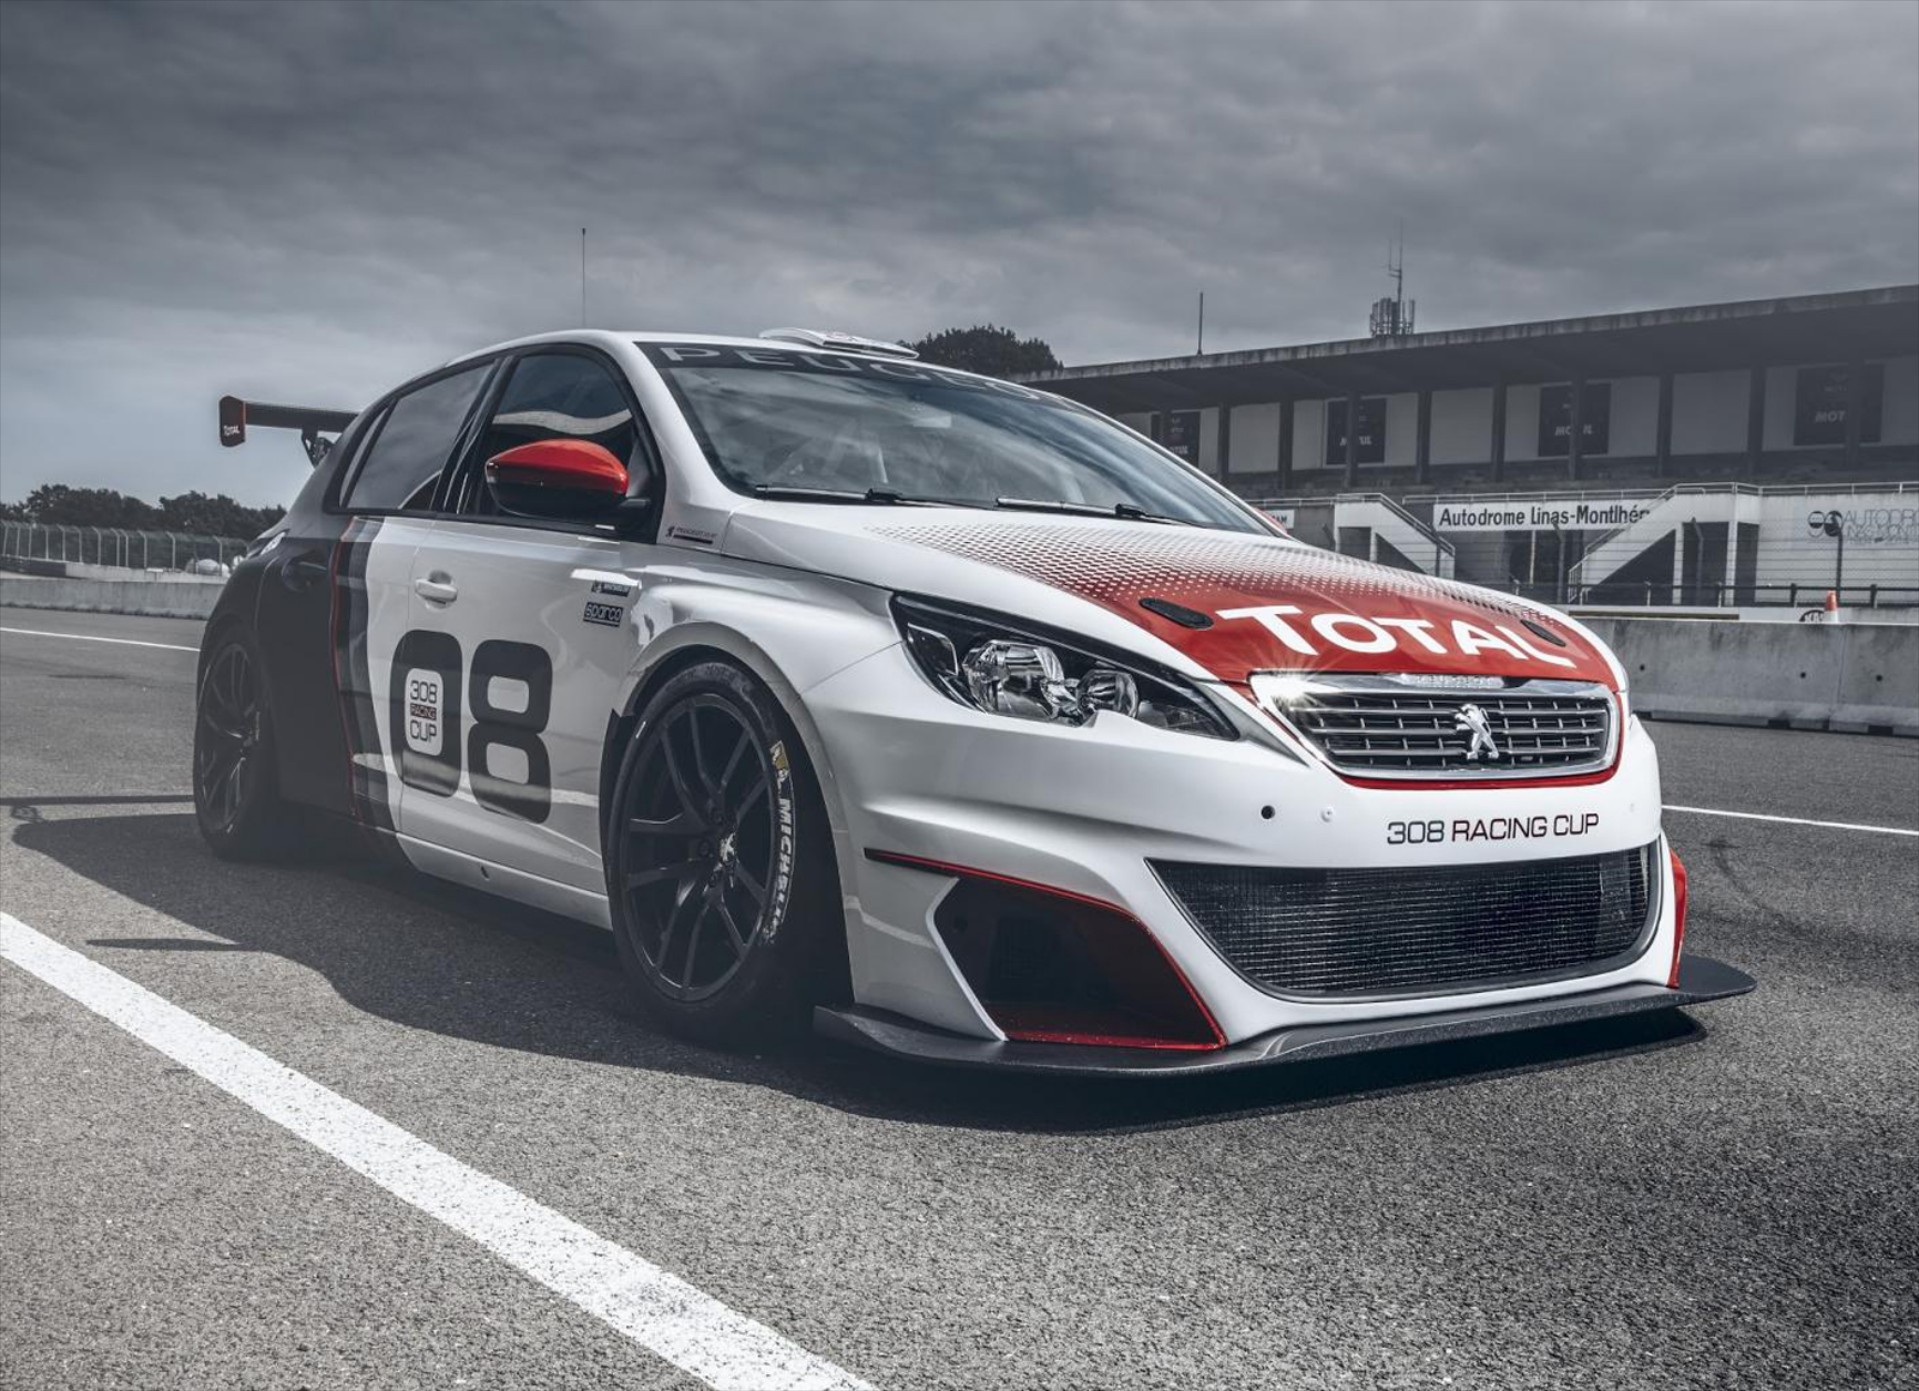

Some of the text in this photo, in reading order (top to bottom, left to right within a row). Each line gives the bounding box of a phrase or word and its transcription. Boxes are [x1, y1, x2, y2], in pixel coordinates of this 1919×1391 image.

[660, 346, 1040, 400] PEUGEO
[1814, 410, 1846, 423] MOT
[1438, 504, 1650, 526] Autodrome Linas-Montlhér
[1215, 605, 1578, 668] TOTAL
[409, 680, 438, 704] 308
[410, 703, 437, 721] RACING
[389, 629, 553, 824] 08
[409, 719, 437, 743] CUP
[1387, 812, 1600, 845] 308 RACING CUP
